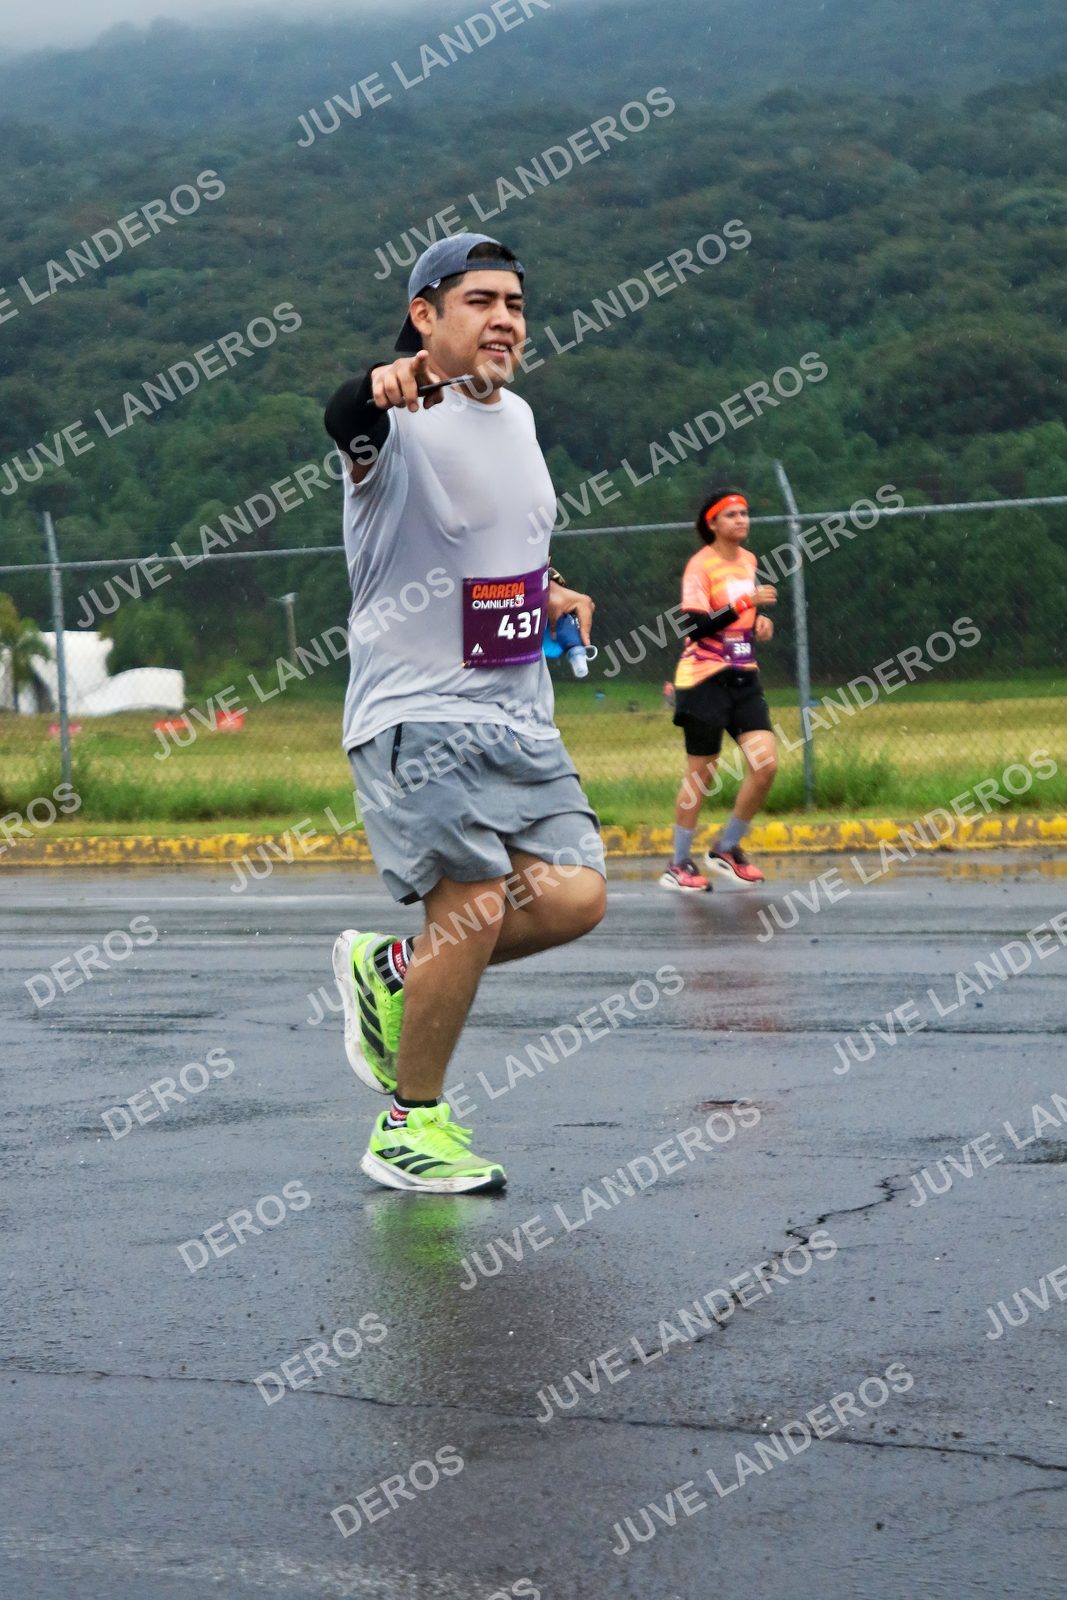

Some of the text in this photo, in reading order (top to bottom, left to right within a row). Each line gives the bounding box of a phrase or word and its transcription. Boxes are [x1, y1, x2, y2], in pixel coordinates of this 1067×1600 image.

[472, 581, 525, 599] CARRERA
[472, 599, 514, 610] OMNILIFE
[497, 607, 542, 640] 437
